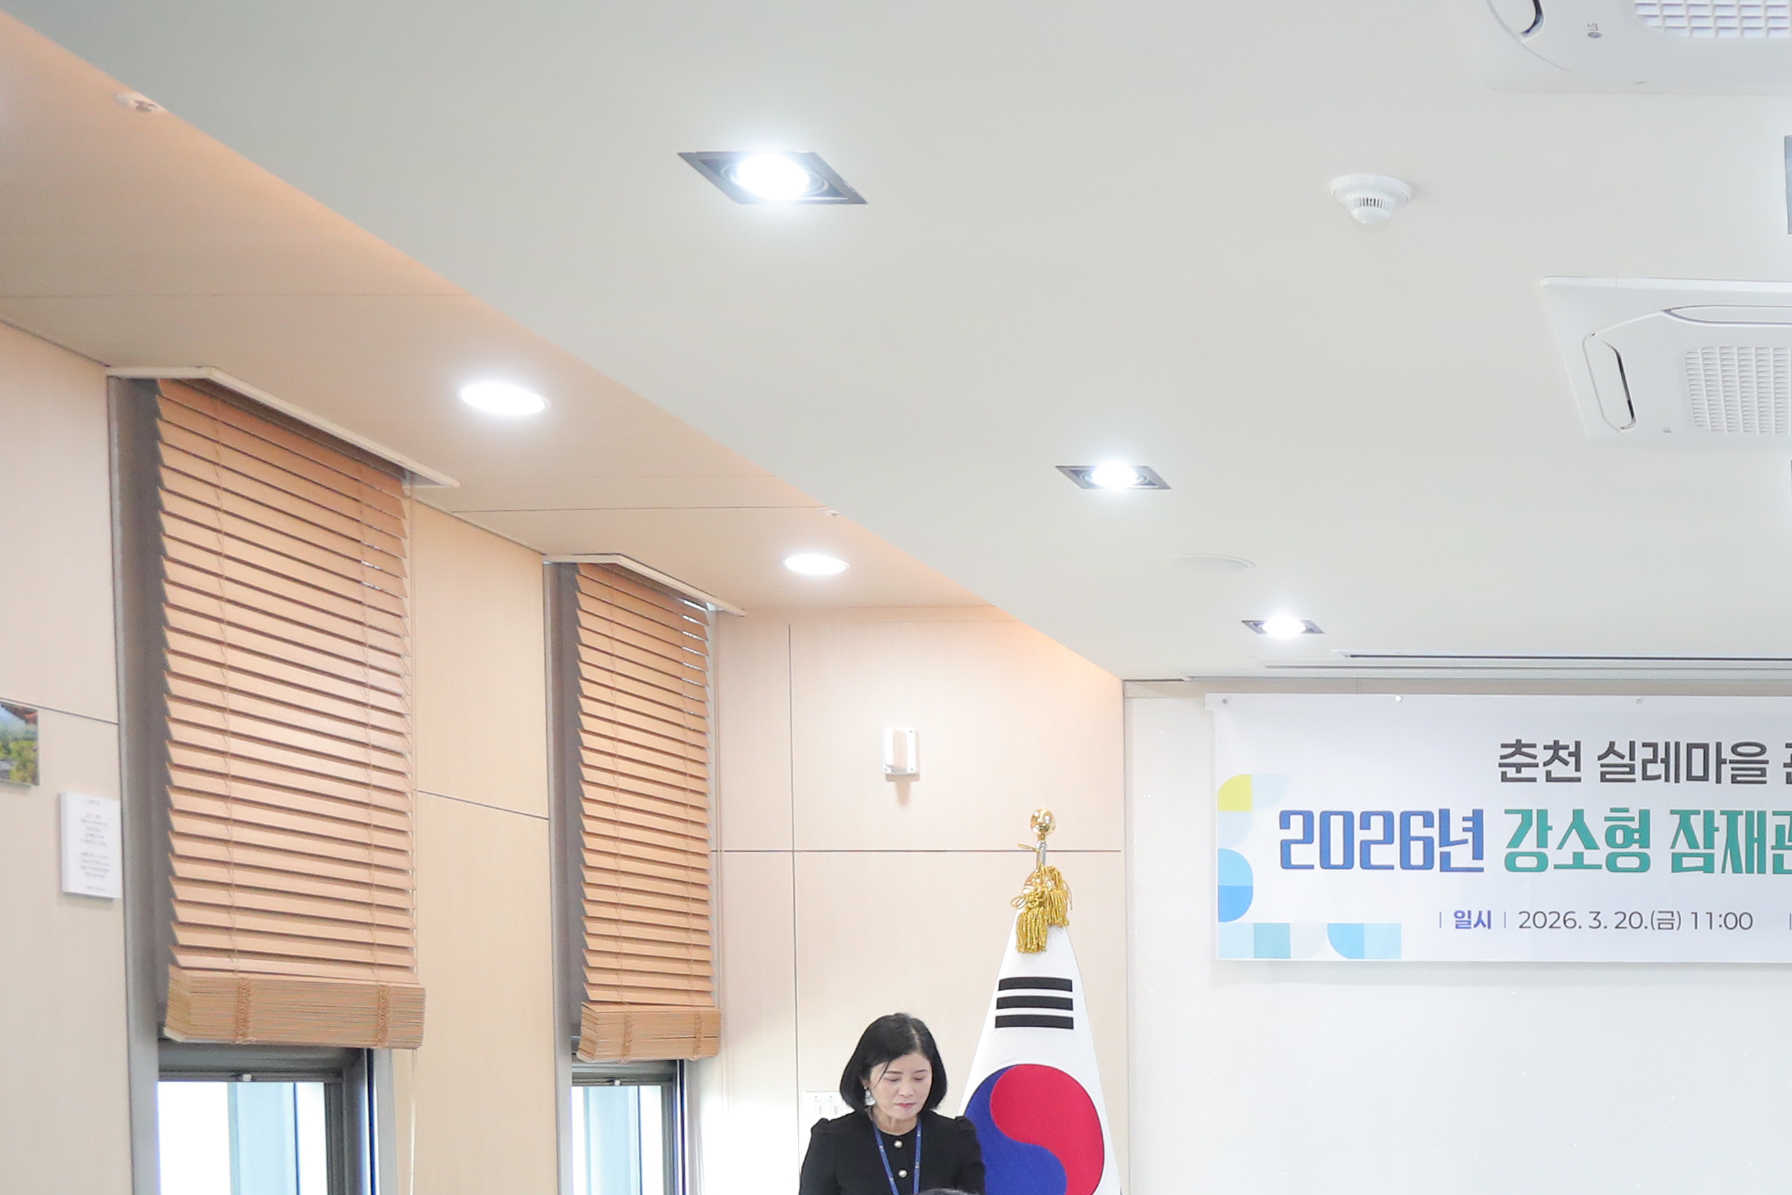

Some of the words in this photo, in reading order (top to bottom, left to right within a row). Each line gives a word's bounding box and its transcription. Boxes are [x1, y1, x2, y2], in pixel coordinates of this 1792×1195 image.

[1497, 738, 1582, 784] 춘천
[1596, 740, 1770, 785] 실레마을
[1278, 807, 1485, 873] 2026년
[1503, 806, 1652, 875] 강소형
[1453, 910, 1492, 930] 일시
[1518, 910, 1582, 930] 2026.
[1588, 910, 1608, 930] 3.
[1690, 911, 1754, 931] 11:00
